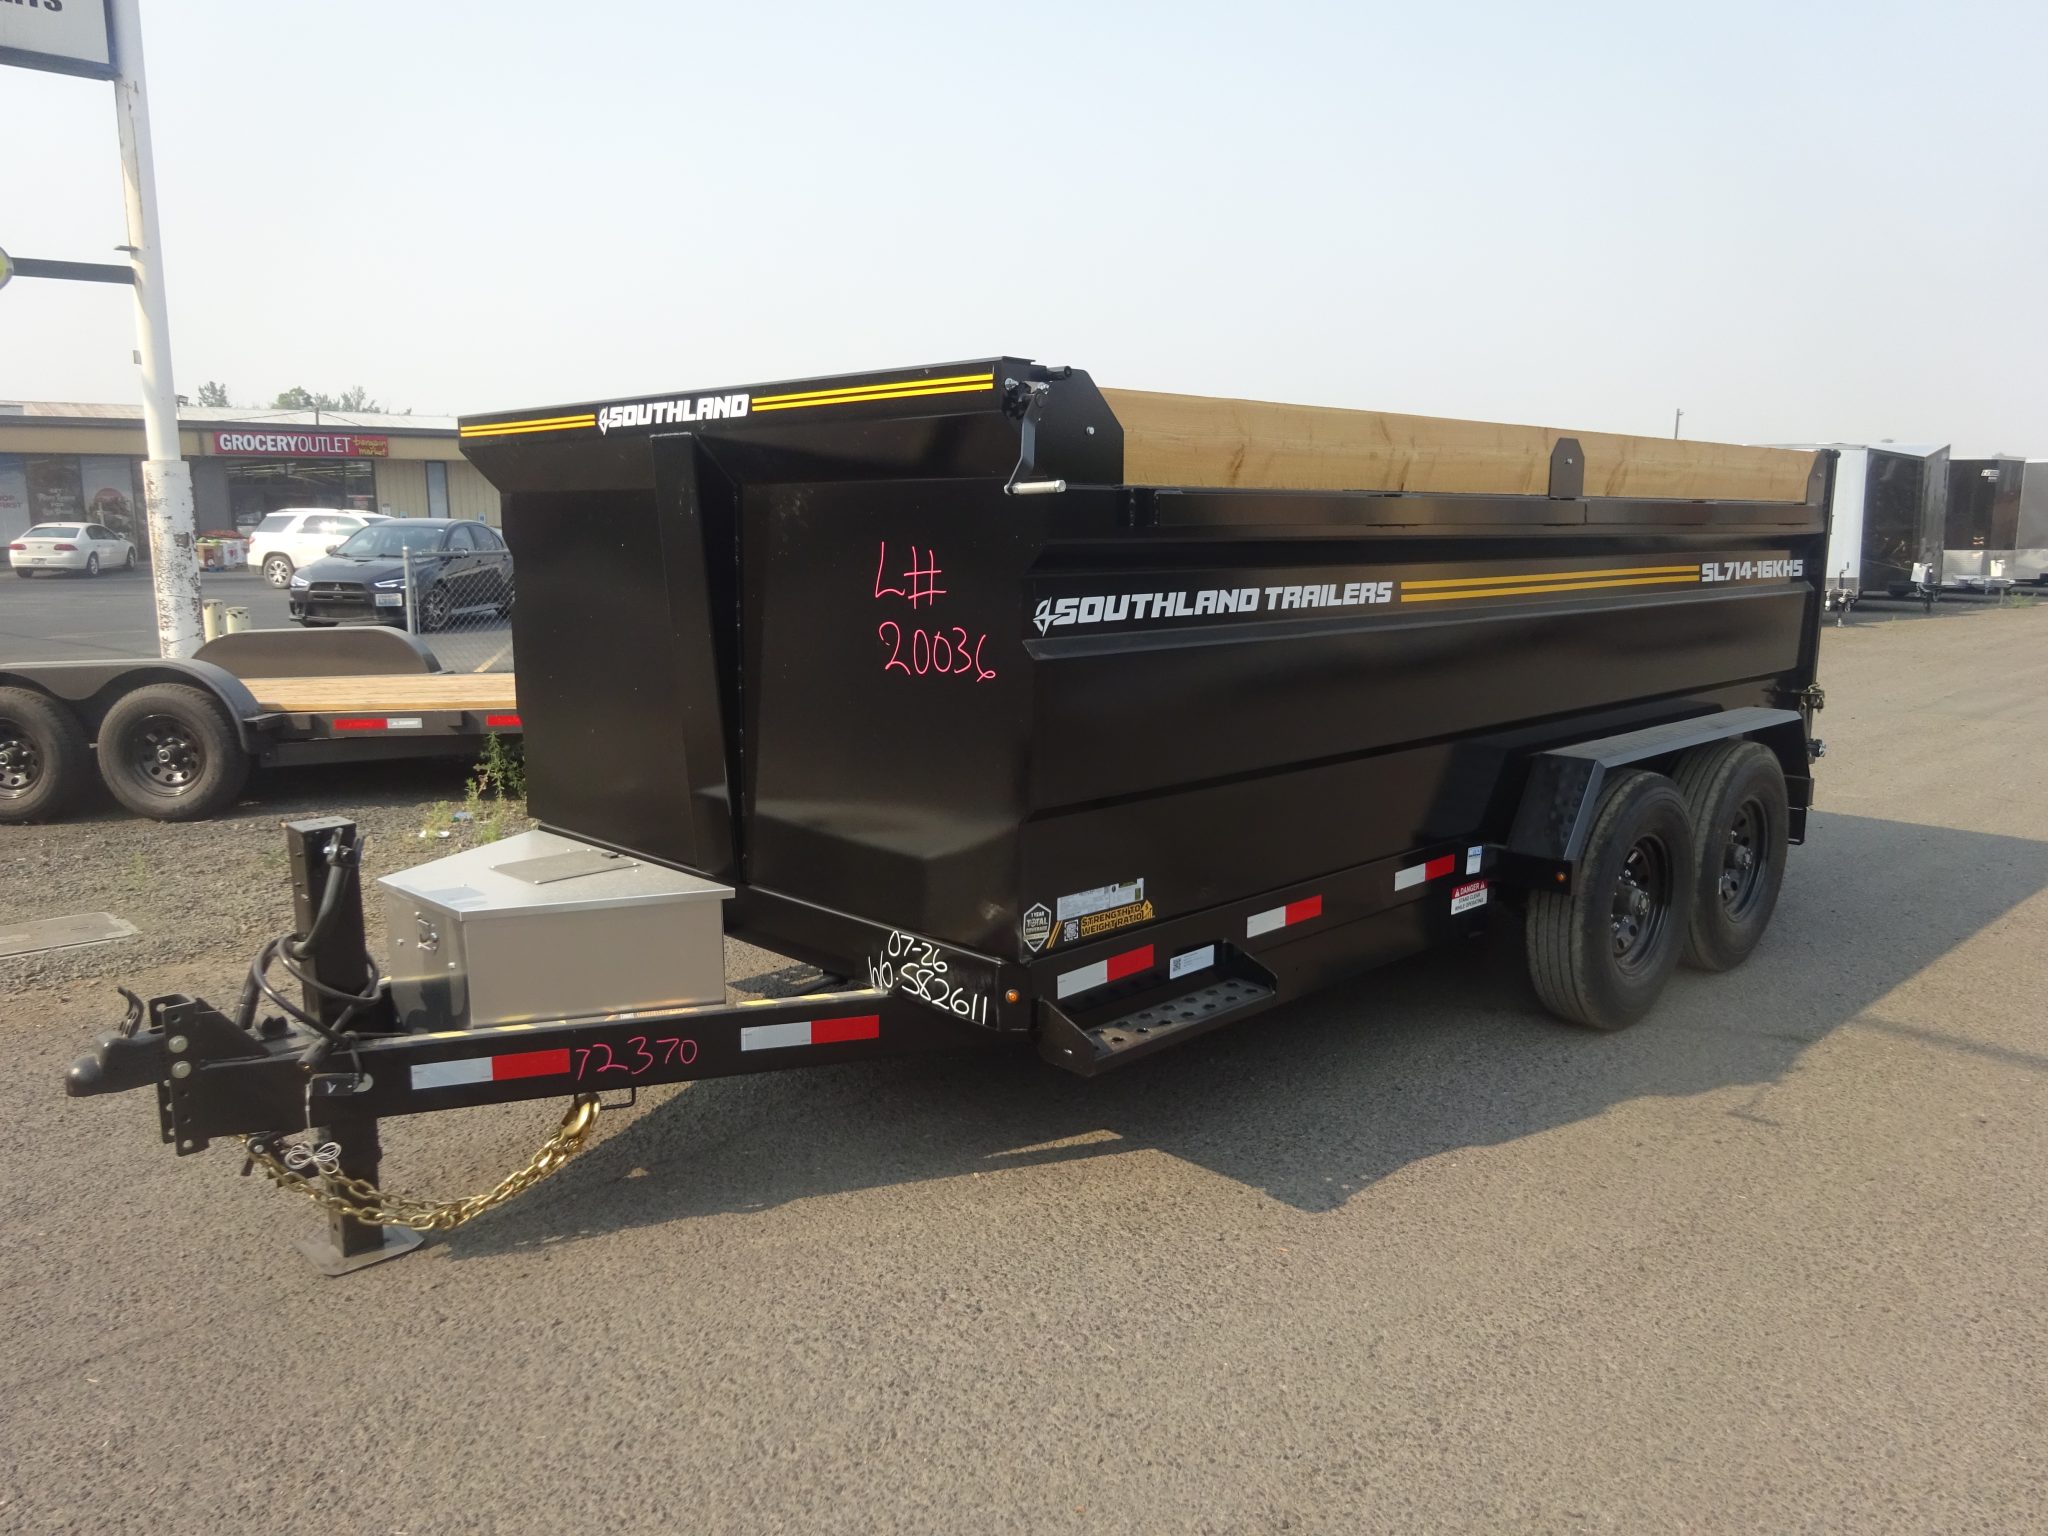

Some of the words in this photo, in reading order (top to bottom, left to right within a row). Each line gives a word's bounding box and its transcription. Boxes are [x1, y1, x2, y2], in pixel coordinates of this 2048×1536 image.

[608, 393, 750, 428] SOUTHLAND
[875, 541, 947, 610] L#
[1701, 559, 1804, 583] SL714-16KHS
[1052, 587, 1260, 626] SOUTHLAND
[1264, 581, 1393, 610] TRAILERS
[878, 621, 996, 682] 20036
[1460, 883, 1480, 895] DANGER
[1026, 917, 1048, 928] TOTAL
[1081, 907, 1128, 927] STRENGTH
[1128, 904, 1141, 915] TO
[1081, 918, 1117, 937] WEIGHT
[887, 929, 949, 973] 07-26
[900, 961, 988, 1026] 582611
[575, 1035, 698, 1081] 72370
